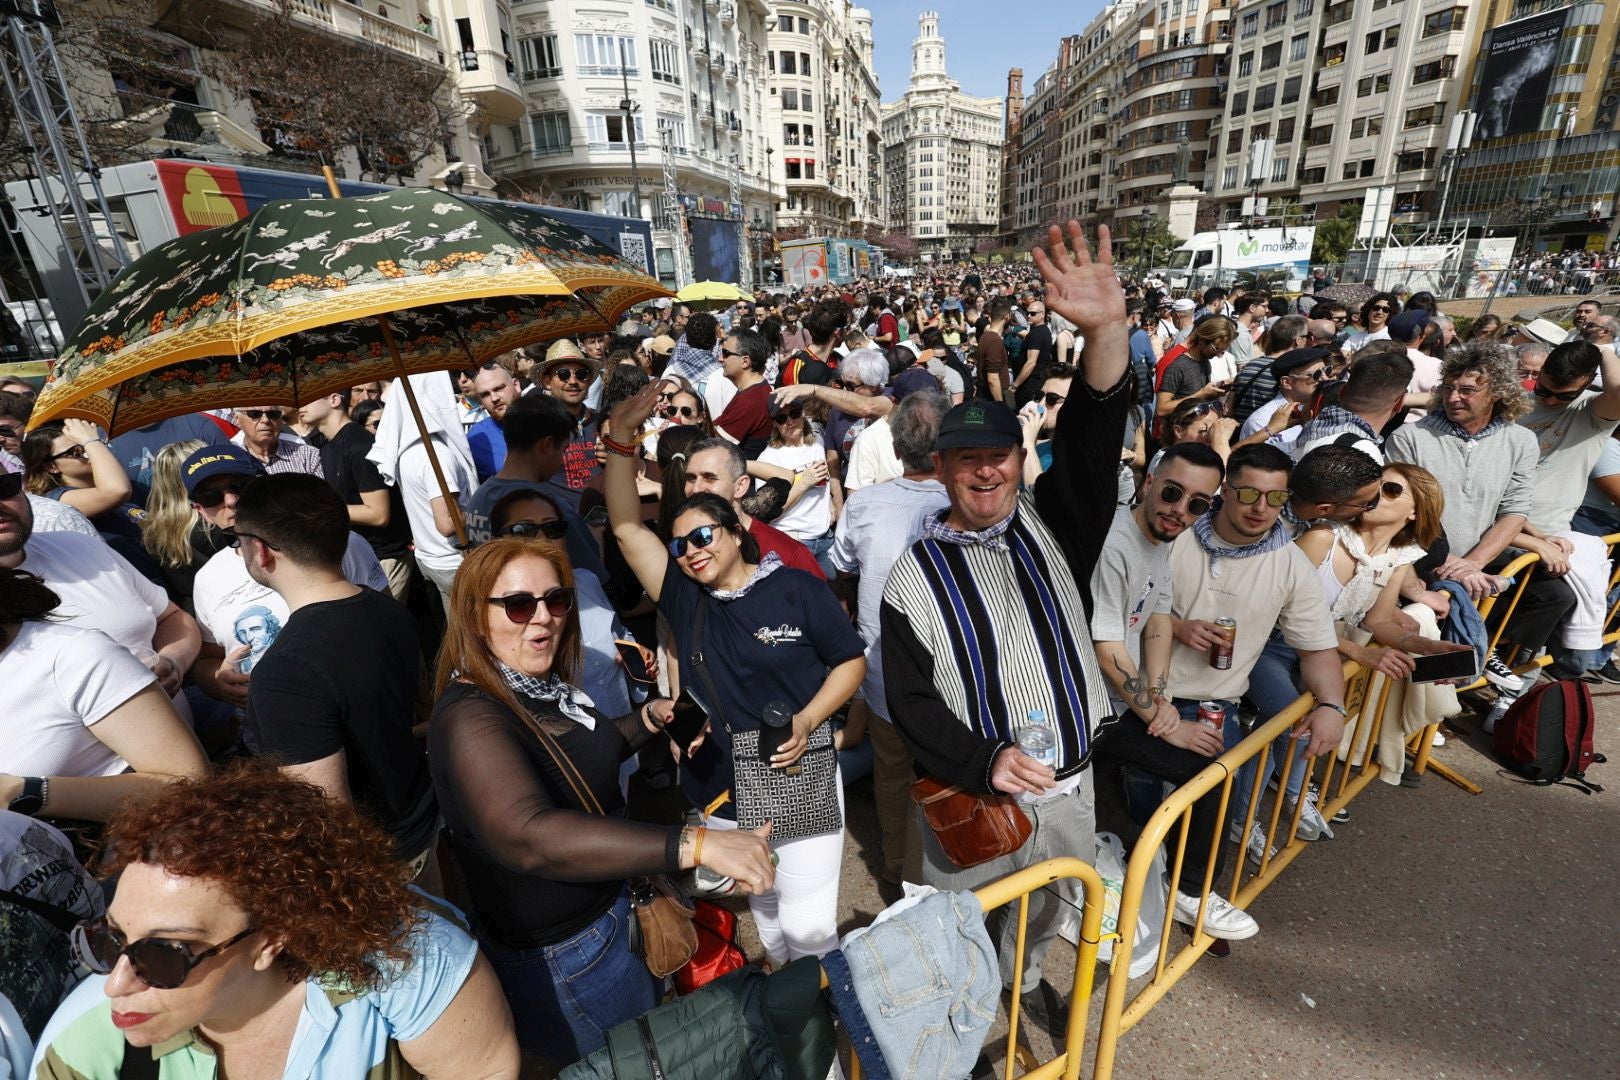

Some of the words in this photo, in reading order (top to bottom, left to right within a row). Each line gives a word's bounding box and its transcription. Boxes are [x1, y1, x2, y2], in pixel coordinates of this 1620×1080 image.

[1261, 239, 1309, 253] movistar
[567, 451, 585, 461] ARE
[569, 459, 598, 470] MEANT
[570, 469, 592, 479] FOR
